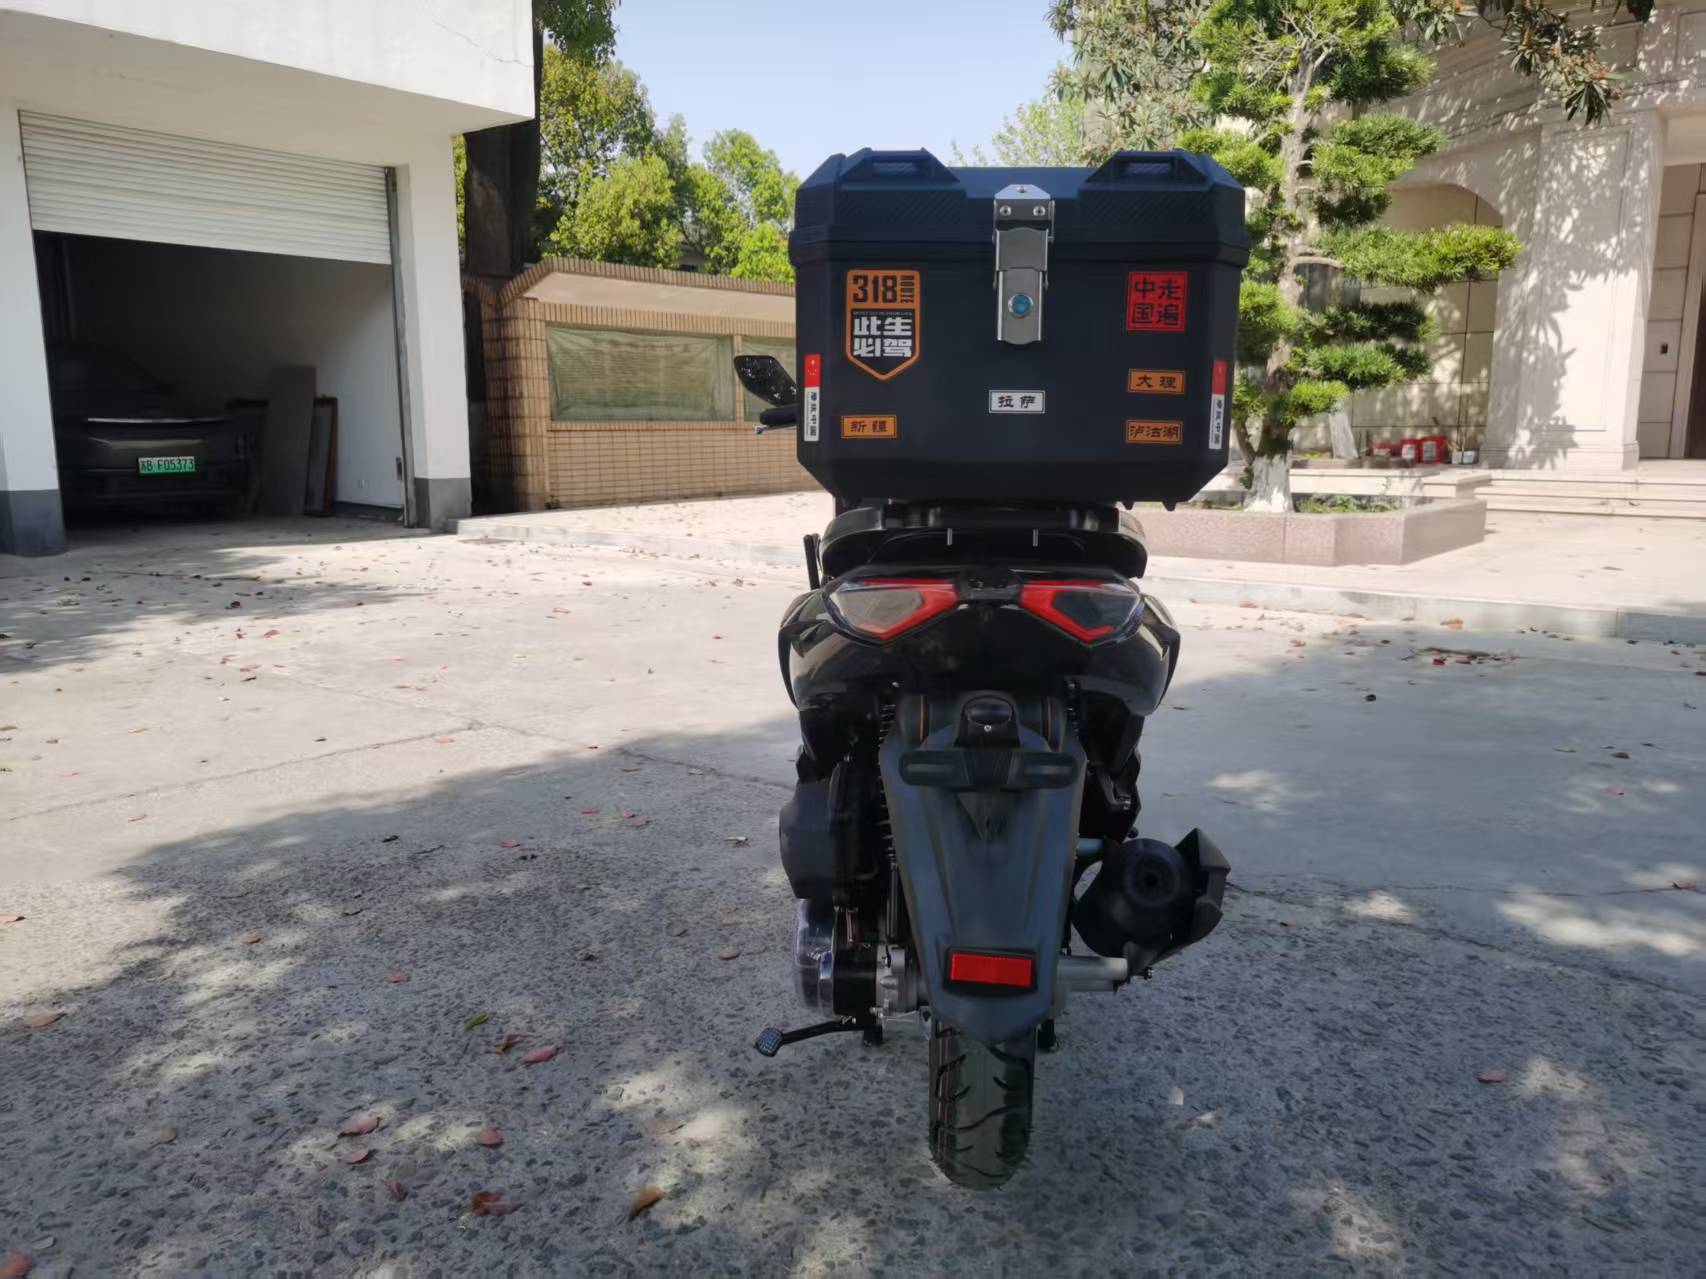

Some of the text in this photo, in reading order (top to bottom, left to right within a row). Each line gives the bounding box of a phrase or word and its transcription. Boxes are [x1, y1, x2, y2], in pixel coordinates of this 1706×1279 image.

[853, 275, 897, 303] 318
[853, 316, 912, 336] 此生
[853, 338, 912, 357] 必驾
[1136, 374, 1177, 389] 大理
[998, 395, 1036, 409] 拉萨
[1130, 425, 1179, 439] 泸沽湖
